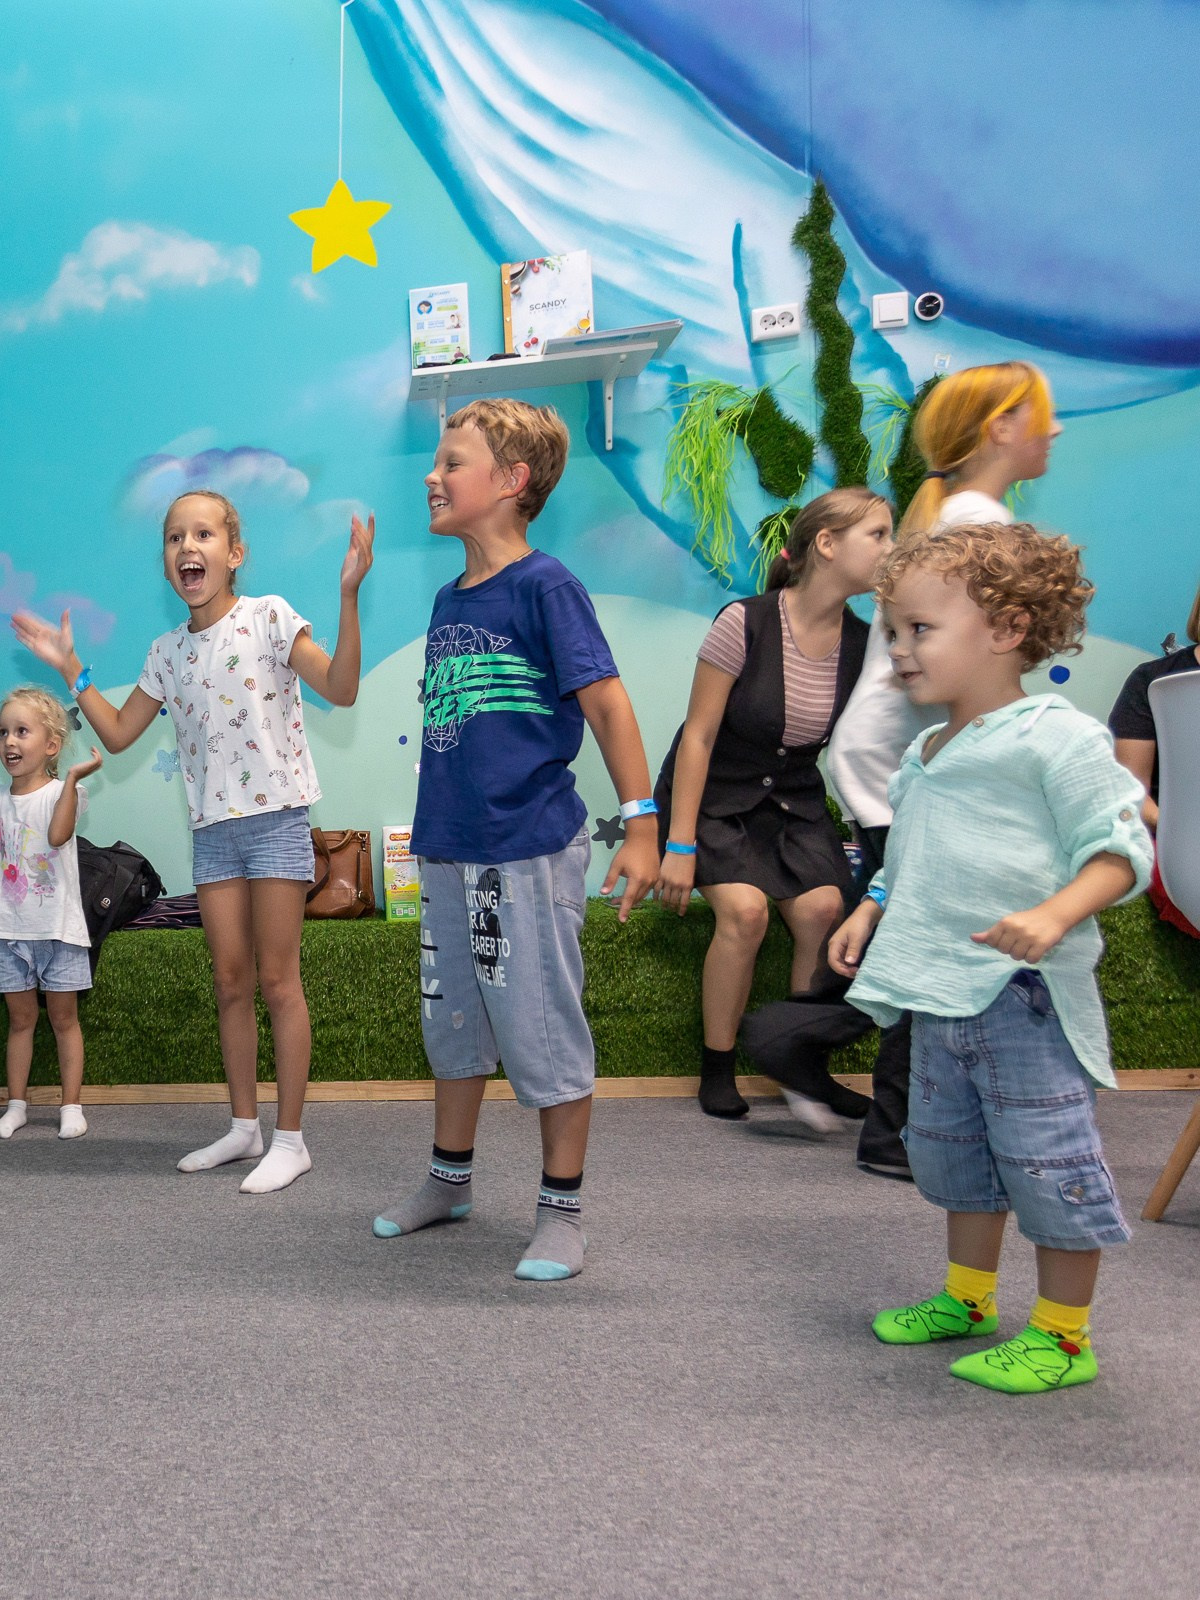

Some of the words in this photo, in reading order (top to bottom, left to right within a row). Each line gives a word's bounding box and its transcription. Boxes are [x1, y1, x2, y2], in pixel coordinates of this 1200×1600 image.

[529, 298, 567, 311] SCANDY
[464, 865, 479, 885] AM
[465, 889, 498, 909] ITING
[480, 912, 488, 930] A
[470, 933, 497, 957] EARER
[497, 937, 511, 958] TO
